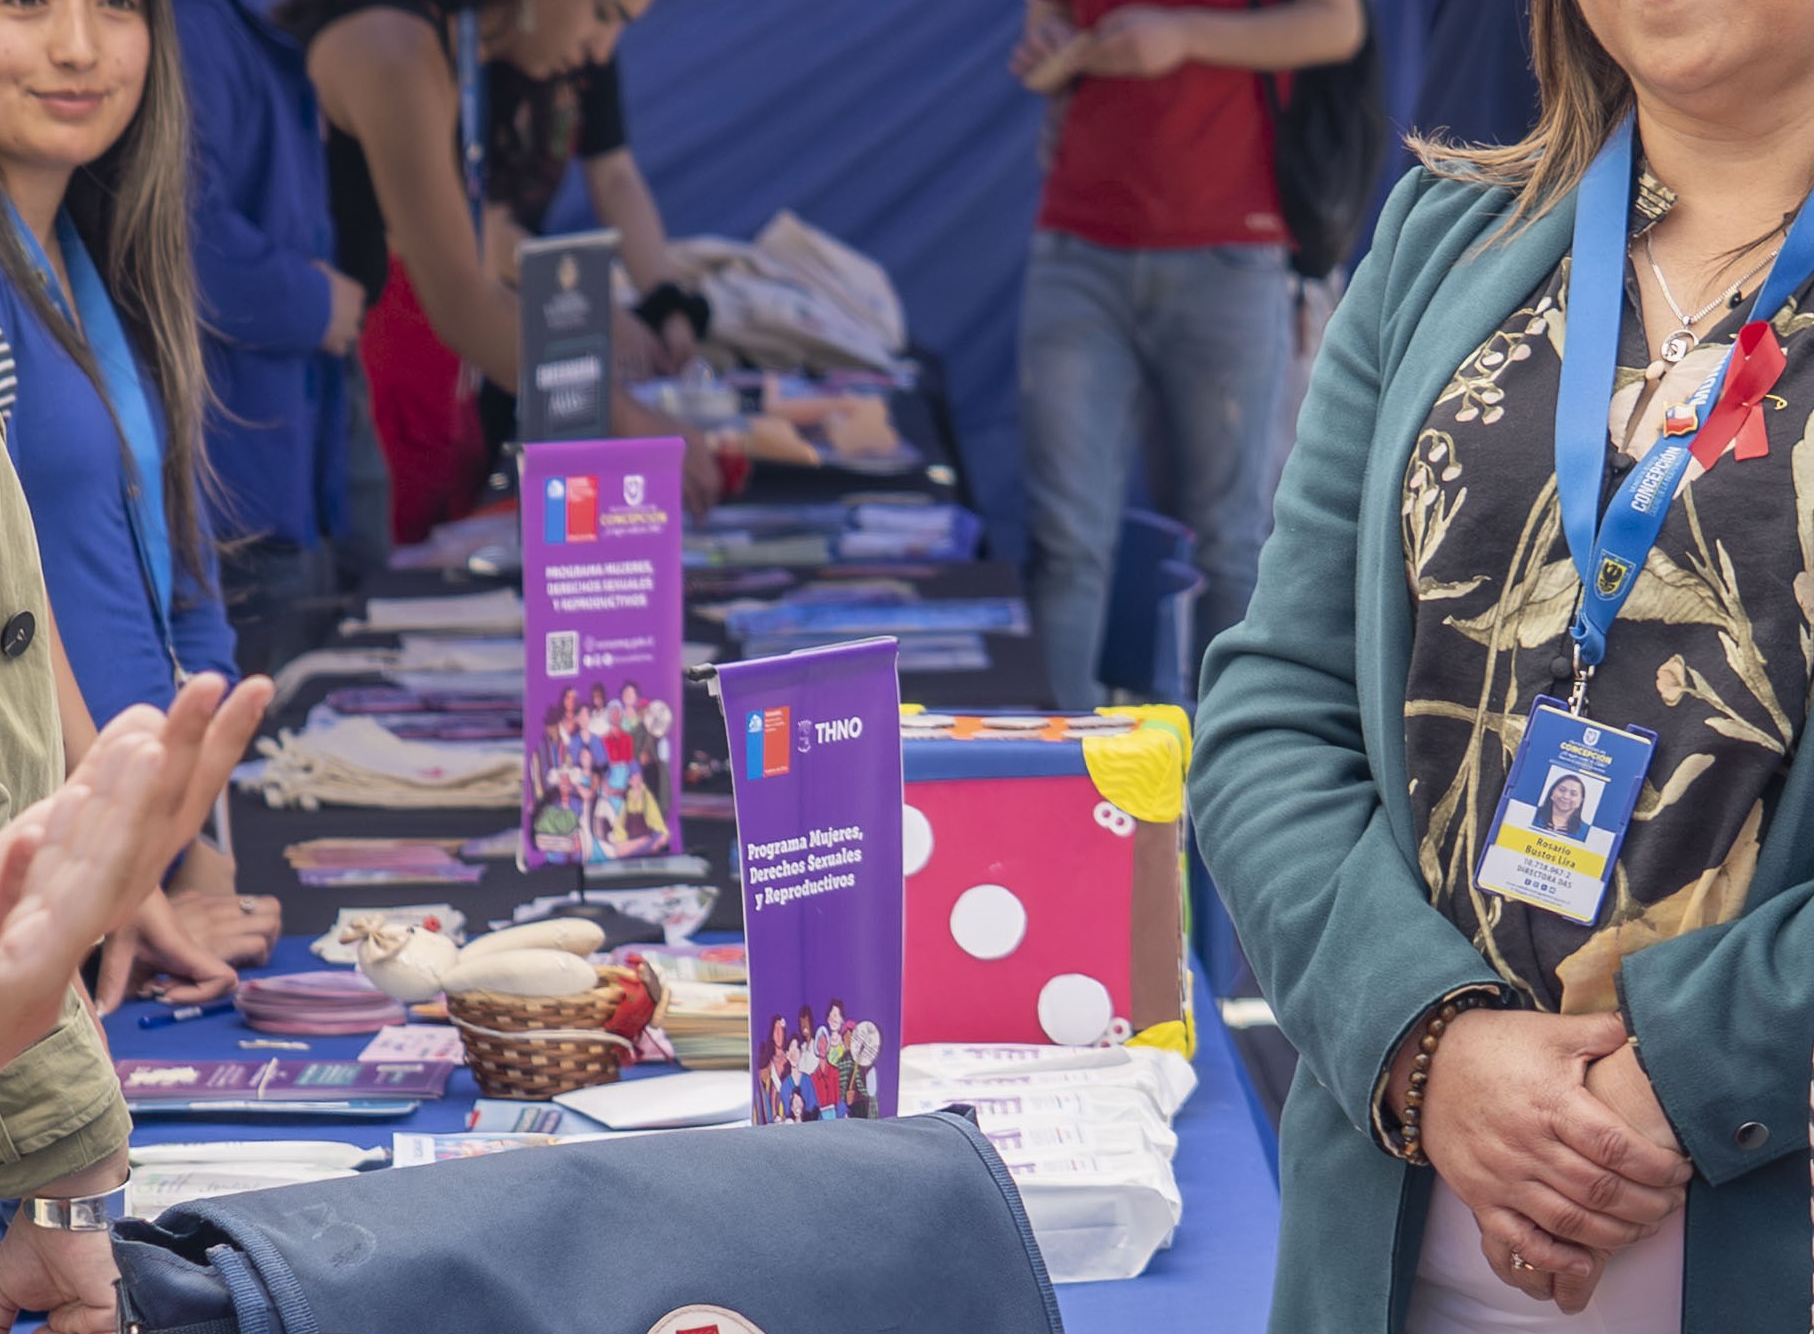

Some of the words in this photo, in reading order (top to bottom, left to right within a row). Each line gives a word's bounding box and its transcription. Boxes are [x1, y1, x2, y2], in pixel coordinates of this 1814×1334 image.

[1630, 446, 1682, 513] CONCEPCIÓN
[815, 717, 863, 744] THNO
[747, 835, 808, 860] Programa
[809, 825, 863, 848] Mujeres,
[1536, 837, 1572, 856] Rosario
[749, 859, 806, 884] Derechos
[807, 847, 862, 871] Sexuales
[755, 892, 764, 911] y
[764, 872, 855, 905] Reproductivos
